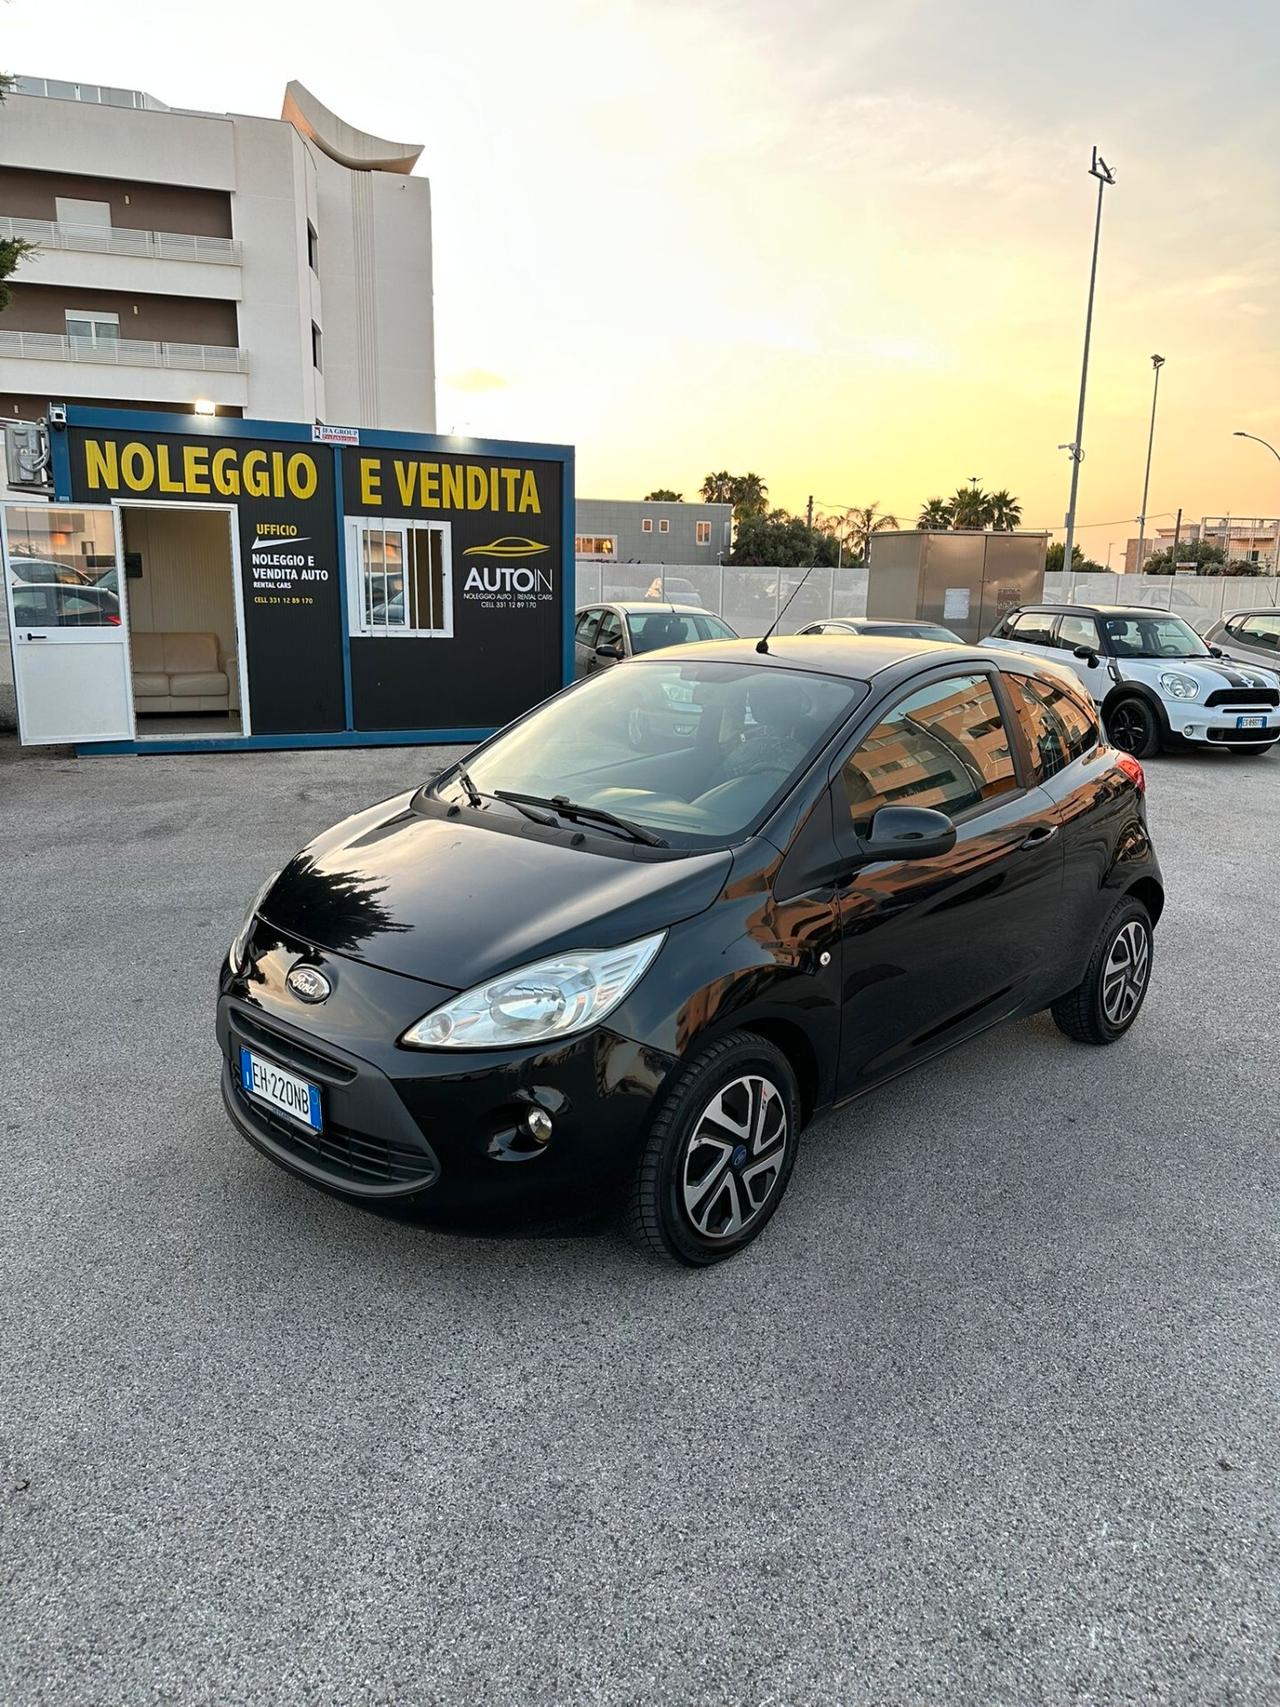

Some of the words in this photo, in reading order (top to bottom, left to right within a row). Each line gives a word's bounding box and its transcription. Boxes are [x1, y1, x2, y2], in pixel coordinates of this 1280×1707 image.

[334, 428, 358, 436] GROUP
[85, 439, 318, 500] NOLEGGIO
[360, 458, 382, 505] E
[393, 460, 542, 514] VENDITA
[256, 523, 297, 536] UFFICIO
[252, 553, 305, 567] NOLEGGIO
[307, 555, 315, 567] E
[252, 567, 298, 580] VENDITA
[300, 569, 329, 581] AUTO
[463, 566, 553, 592] AUTOIN
[253, 581, 276, 589] RENTAL
[254, 596, 268, 604] CELL
[269, 596, 280, 604] 331
[301, 597, 314, 605] 170
[463, 592, 496, 600] NOLEGGIO
[516, 593, 537, 601] RENTAL
[537, 593, 553, 601] CARS
[292, 972, 319, 995] Ford
